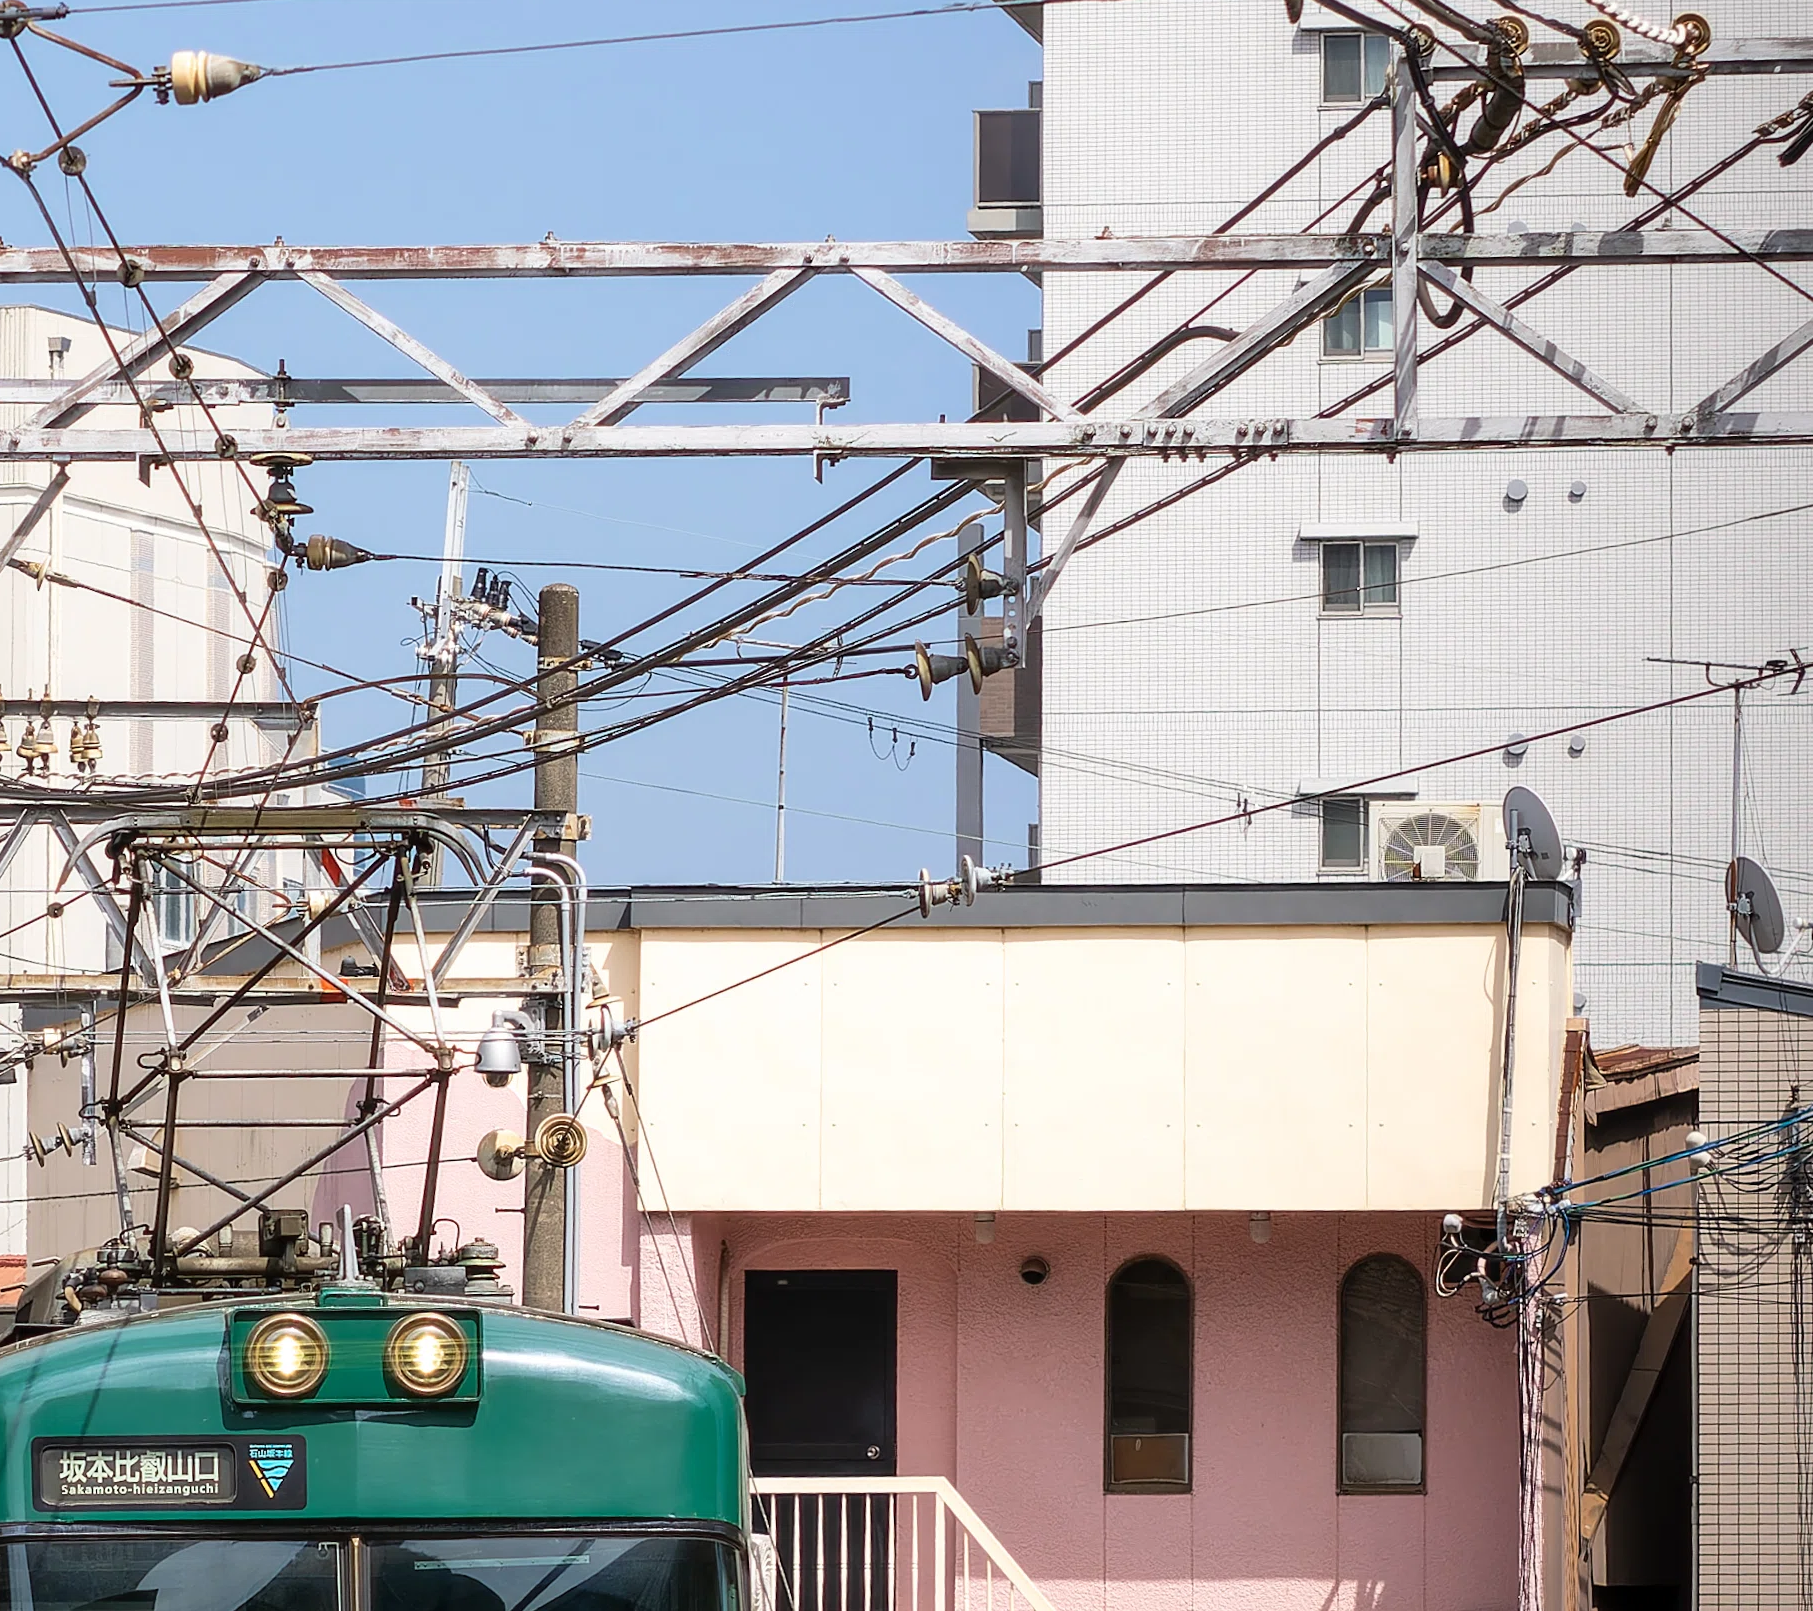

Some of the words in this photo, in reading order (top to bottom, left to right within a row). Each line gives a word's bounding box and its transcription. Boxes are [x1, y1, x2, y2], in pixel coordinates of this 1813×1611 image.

[58, 1450, 219, 1484] 坂本比叡山口
[61, 1484, 220, 1497] Sakamoto-hieizanguchi
